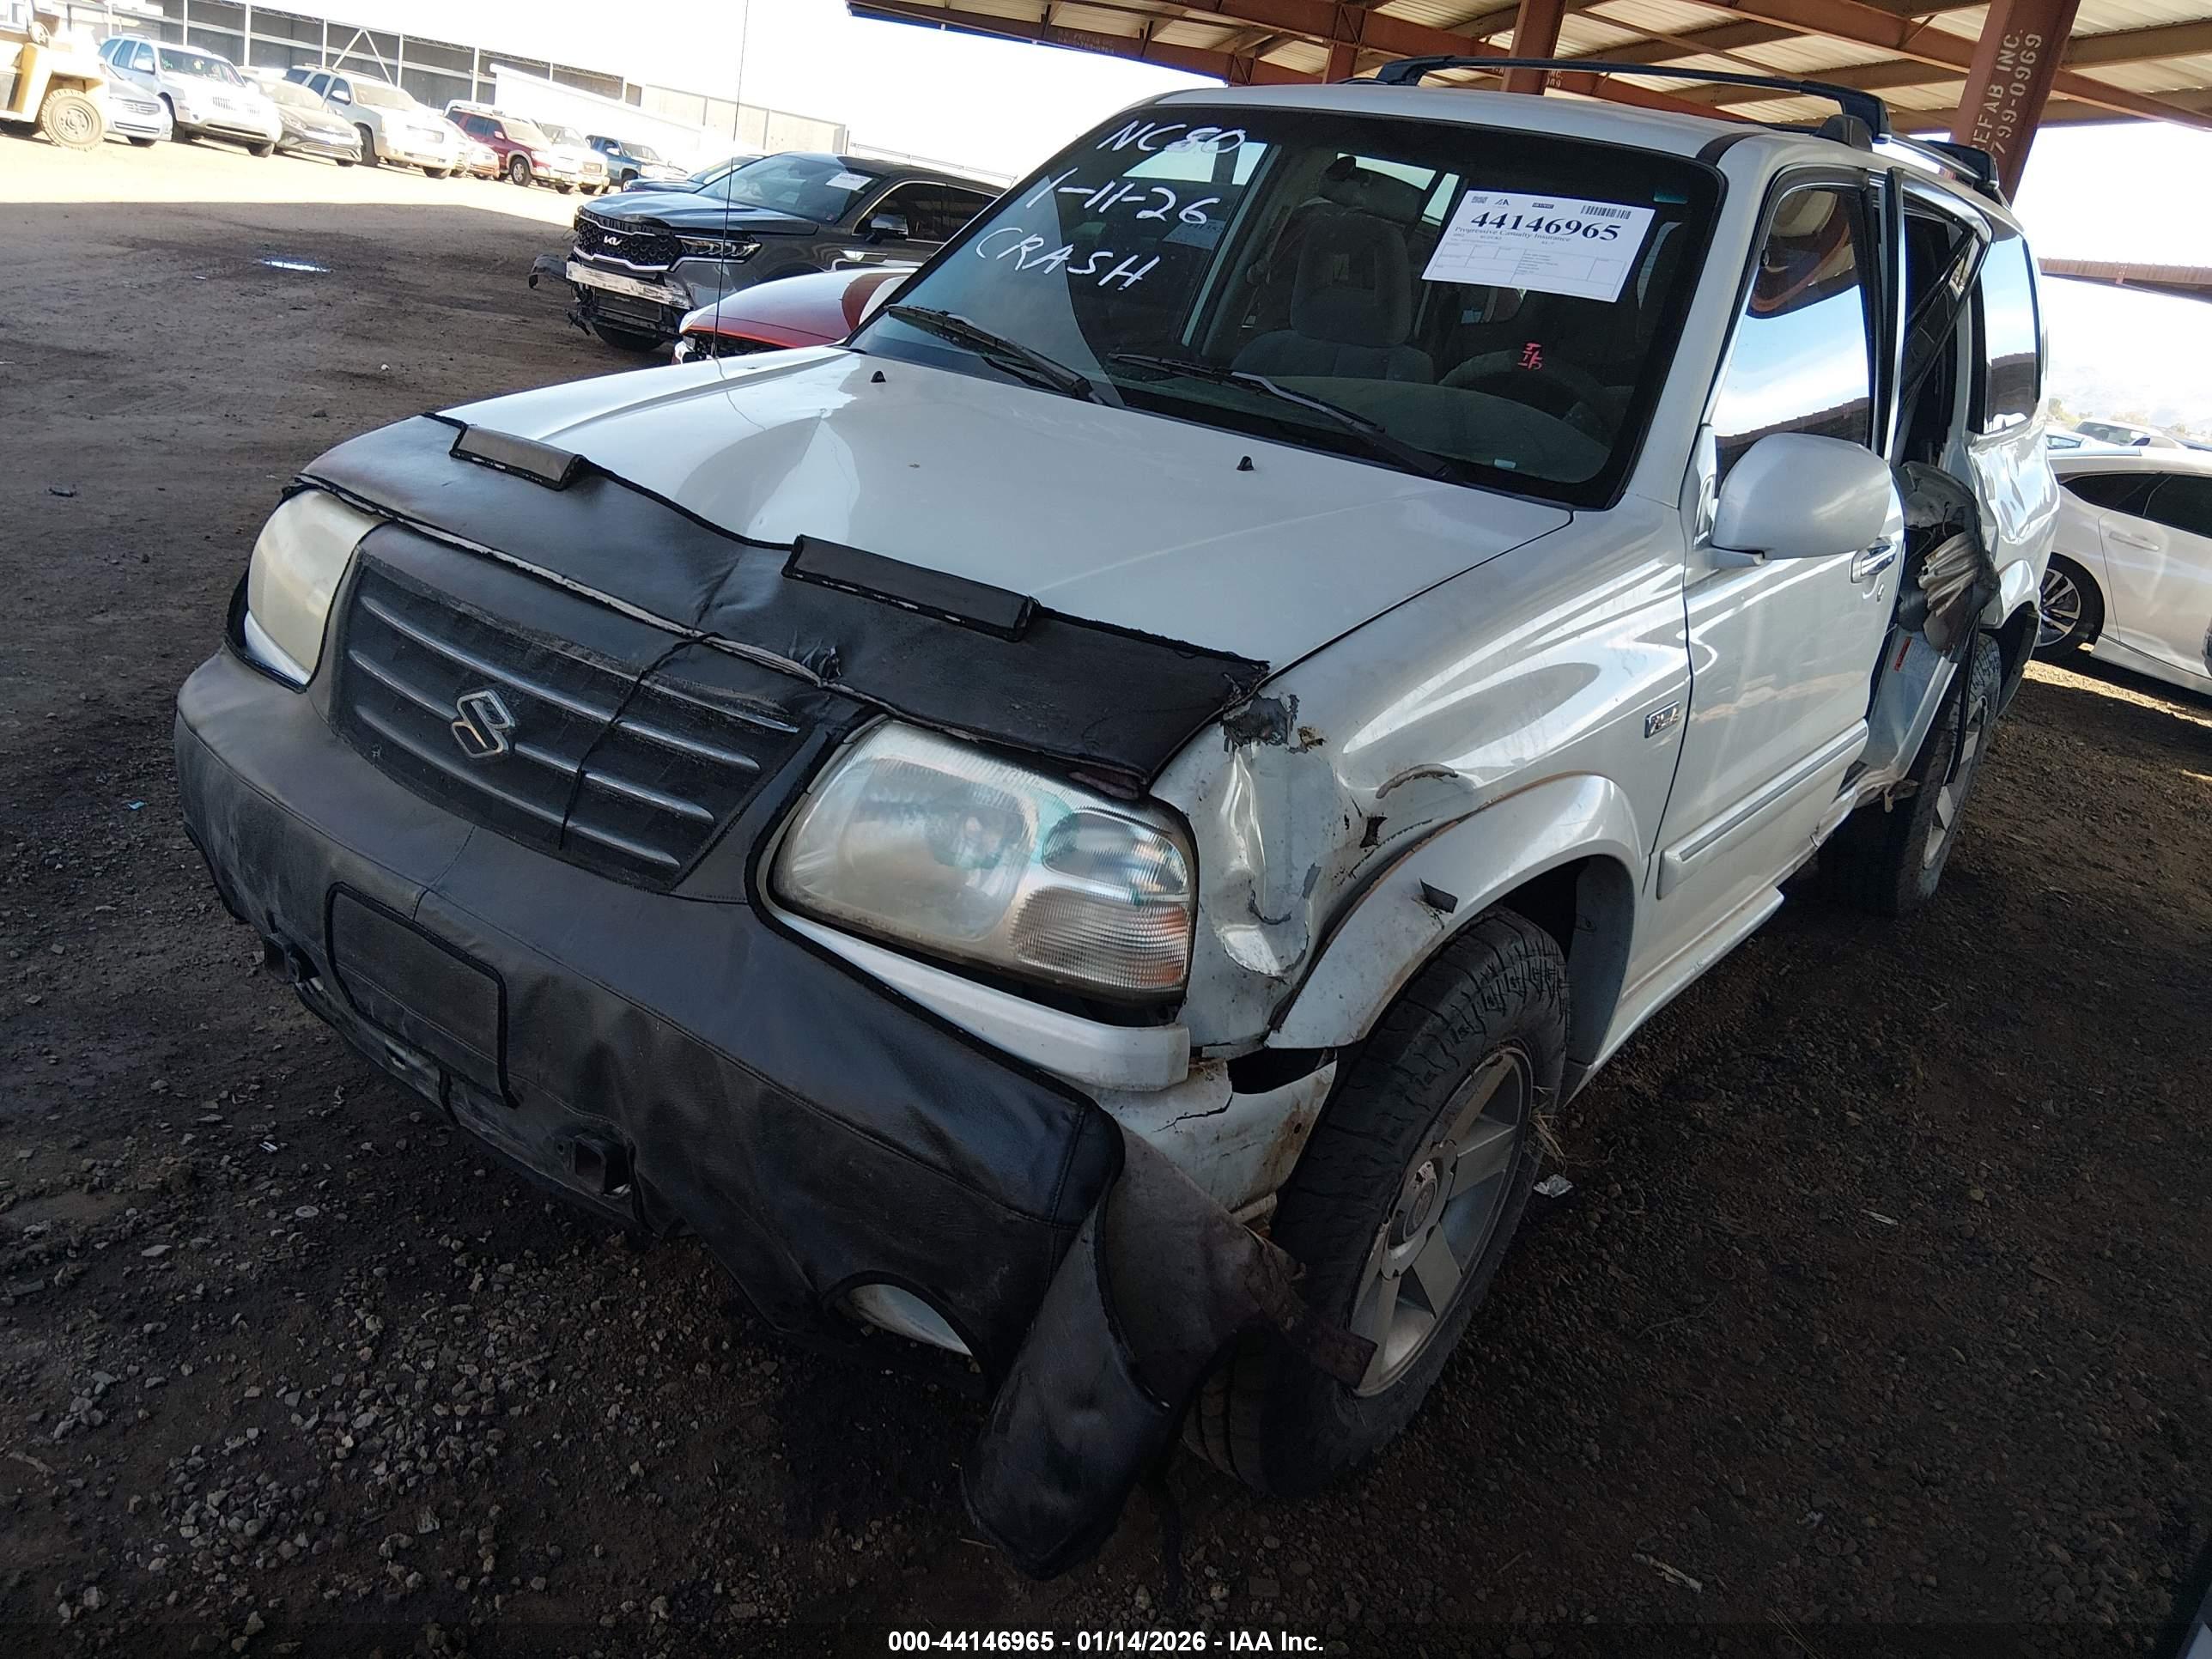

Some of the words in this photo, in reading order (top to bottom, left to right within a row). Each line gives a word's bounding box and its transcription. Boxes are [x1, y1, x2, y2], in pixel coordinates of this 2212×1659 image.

[1455, 226, 1498, 234] Progressive
[1499, 230, 1532, 239] Casualty
[1534, 233, 1571, 242] Insurance
[1471, 211, 1622, 241] 44146965
[975, 227, 1161, 291] CRASH
